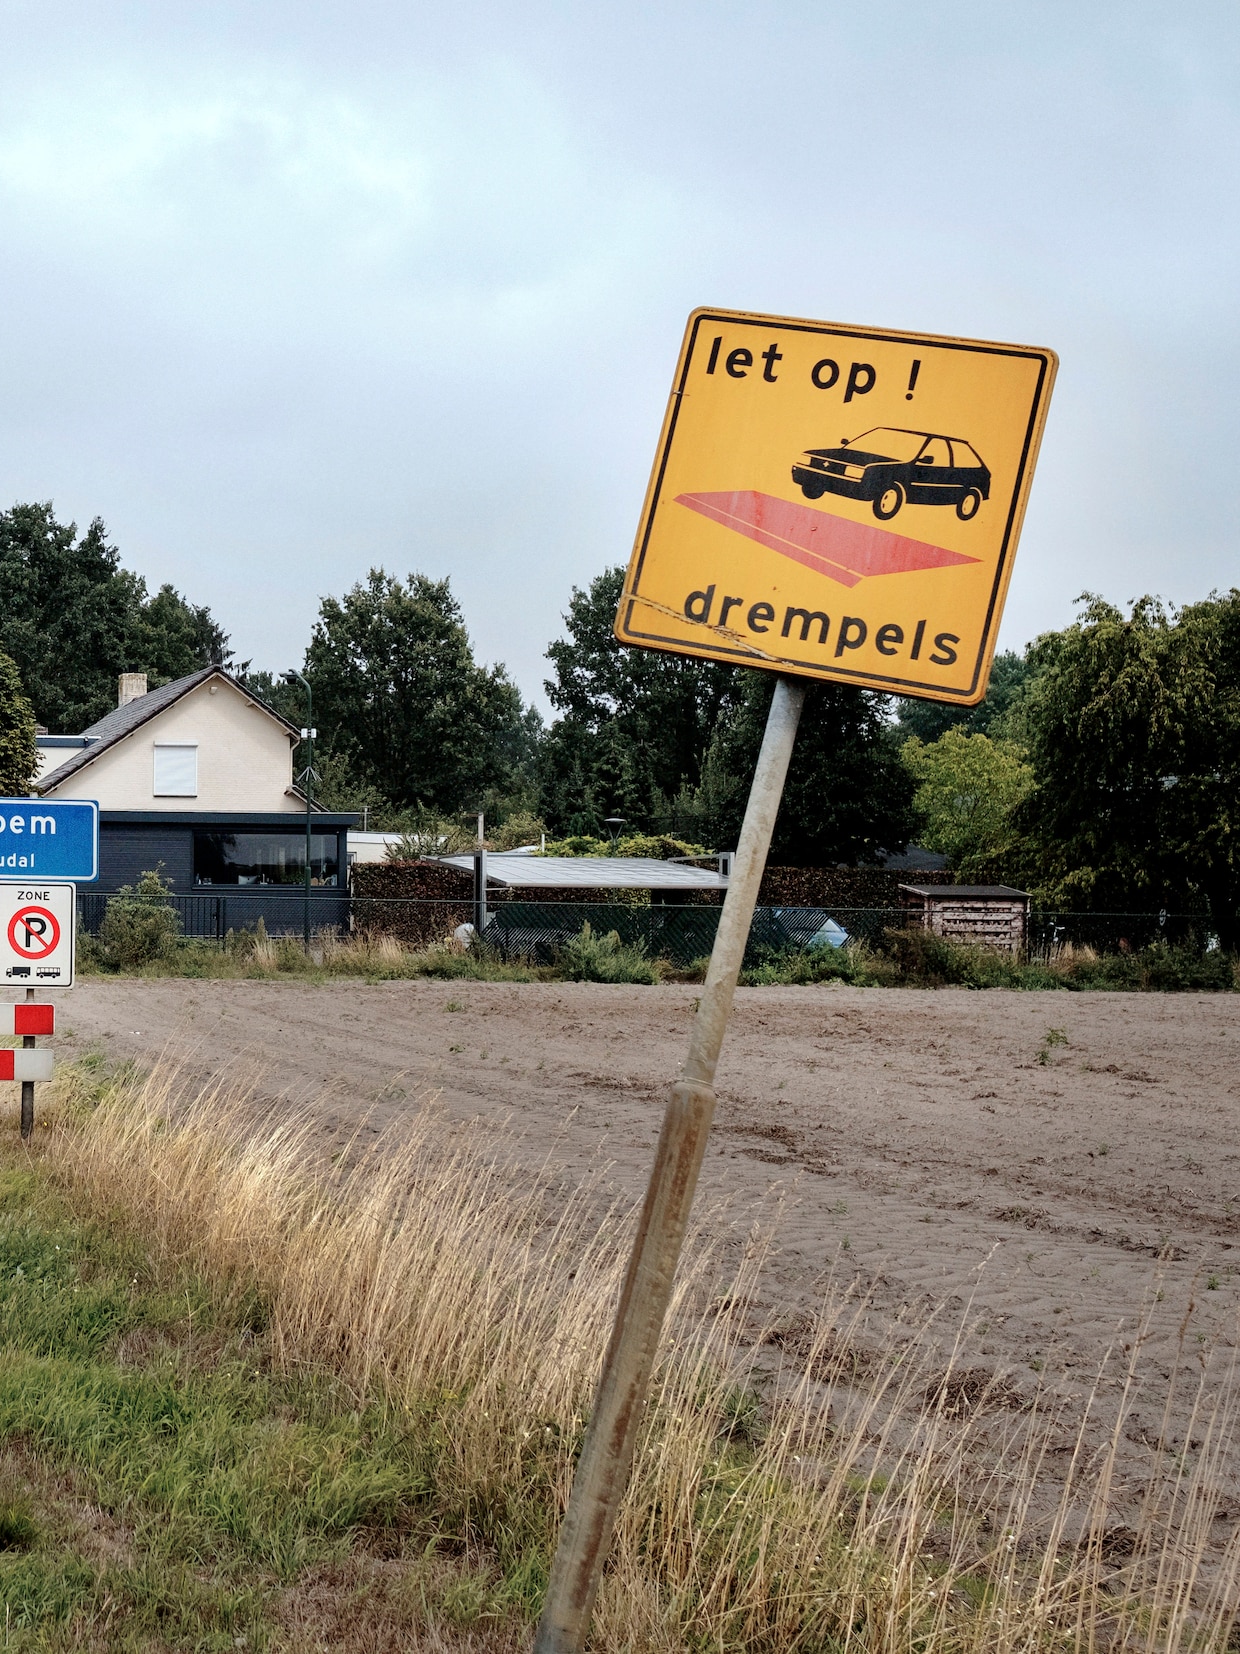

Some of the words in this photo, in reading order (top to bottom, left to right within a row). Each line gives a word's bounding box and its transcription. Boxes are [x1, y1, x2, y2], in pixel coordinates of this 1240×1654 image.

[706, 336, 783, 383] let
[811, 358, 877, 404] op
[905, 359, 922, 401] !
[683, 584, 961, 666] drempels
[17, 890, 51, 901] ZONE
[24, 917, 47, 948] P
